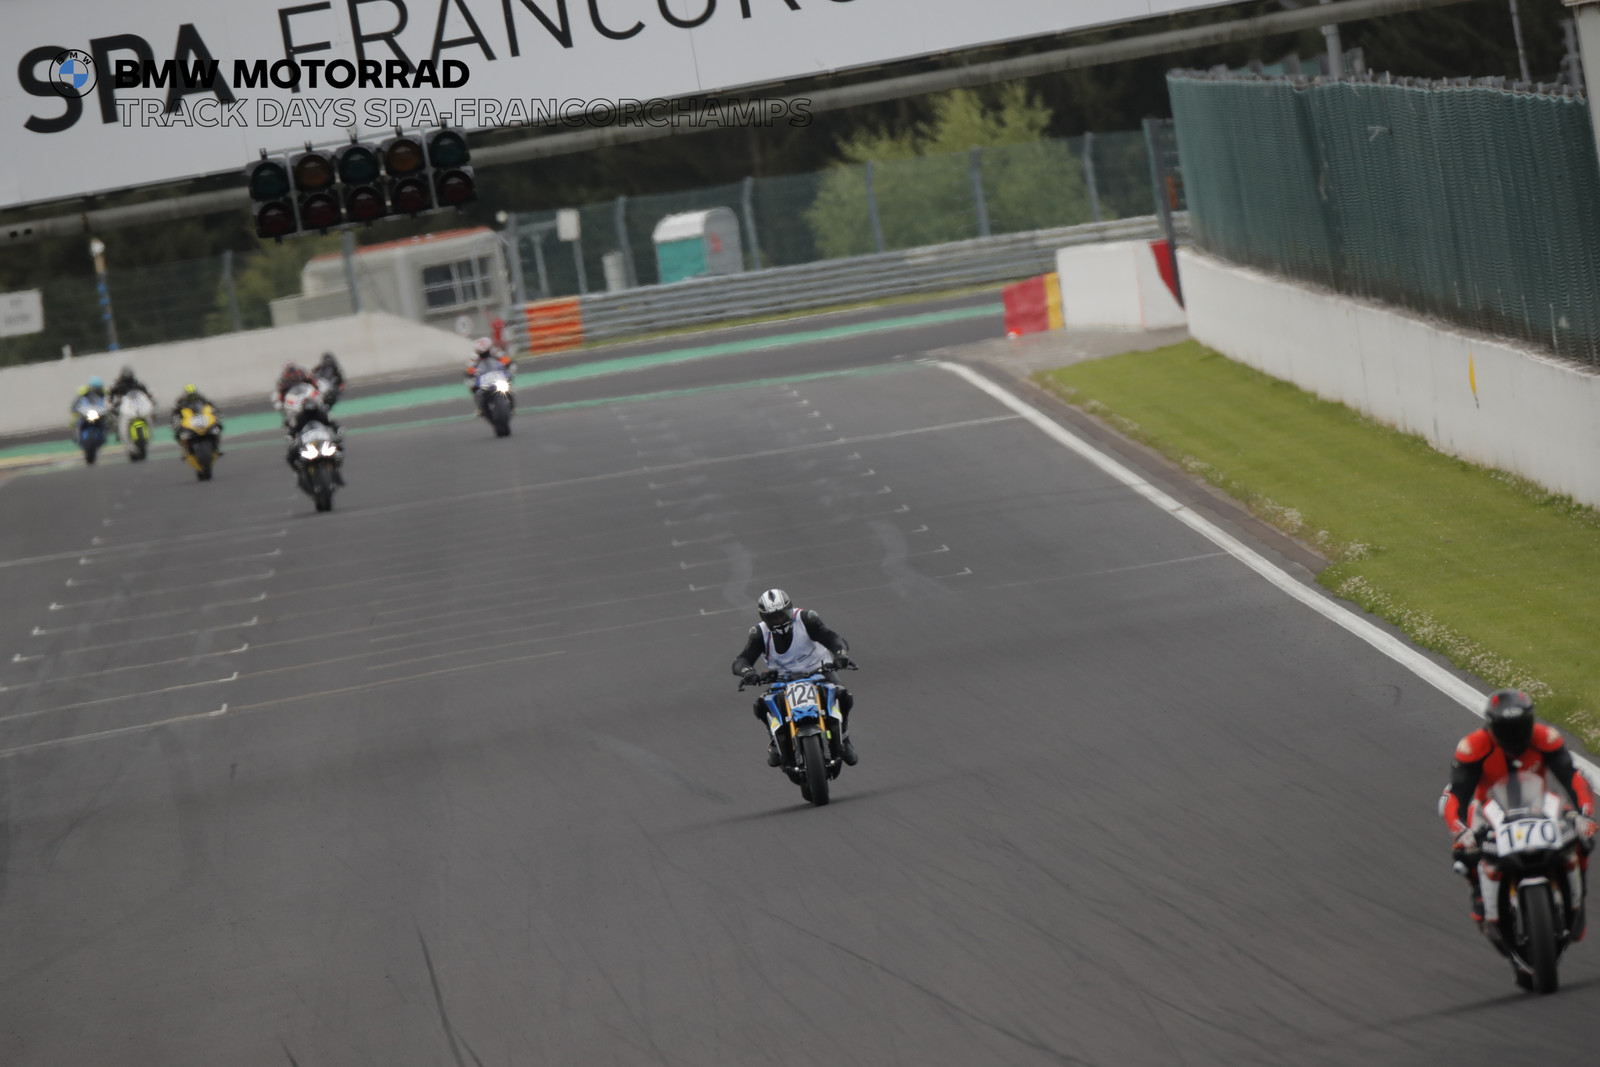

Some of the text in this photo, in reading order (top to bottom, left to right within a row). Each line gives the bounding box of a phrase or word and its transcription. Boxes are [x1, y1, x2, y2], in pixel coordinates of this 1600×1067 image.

[18, 23, 236, 134] SPA
[787, 684, 818, 707] 124
[1500, 820, 1557, 849] 170
